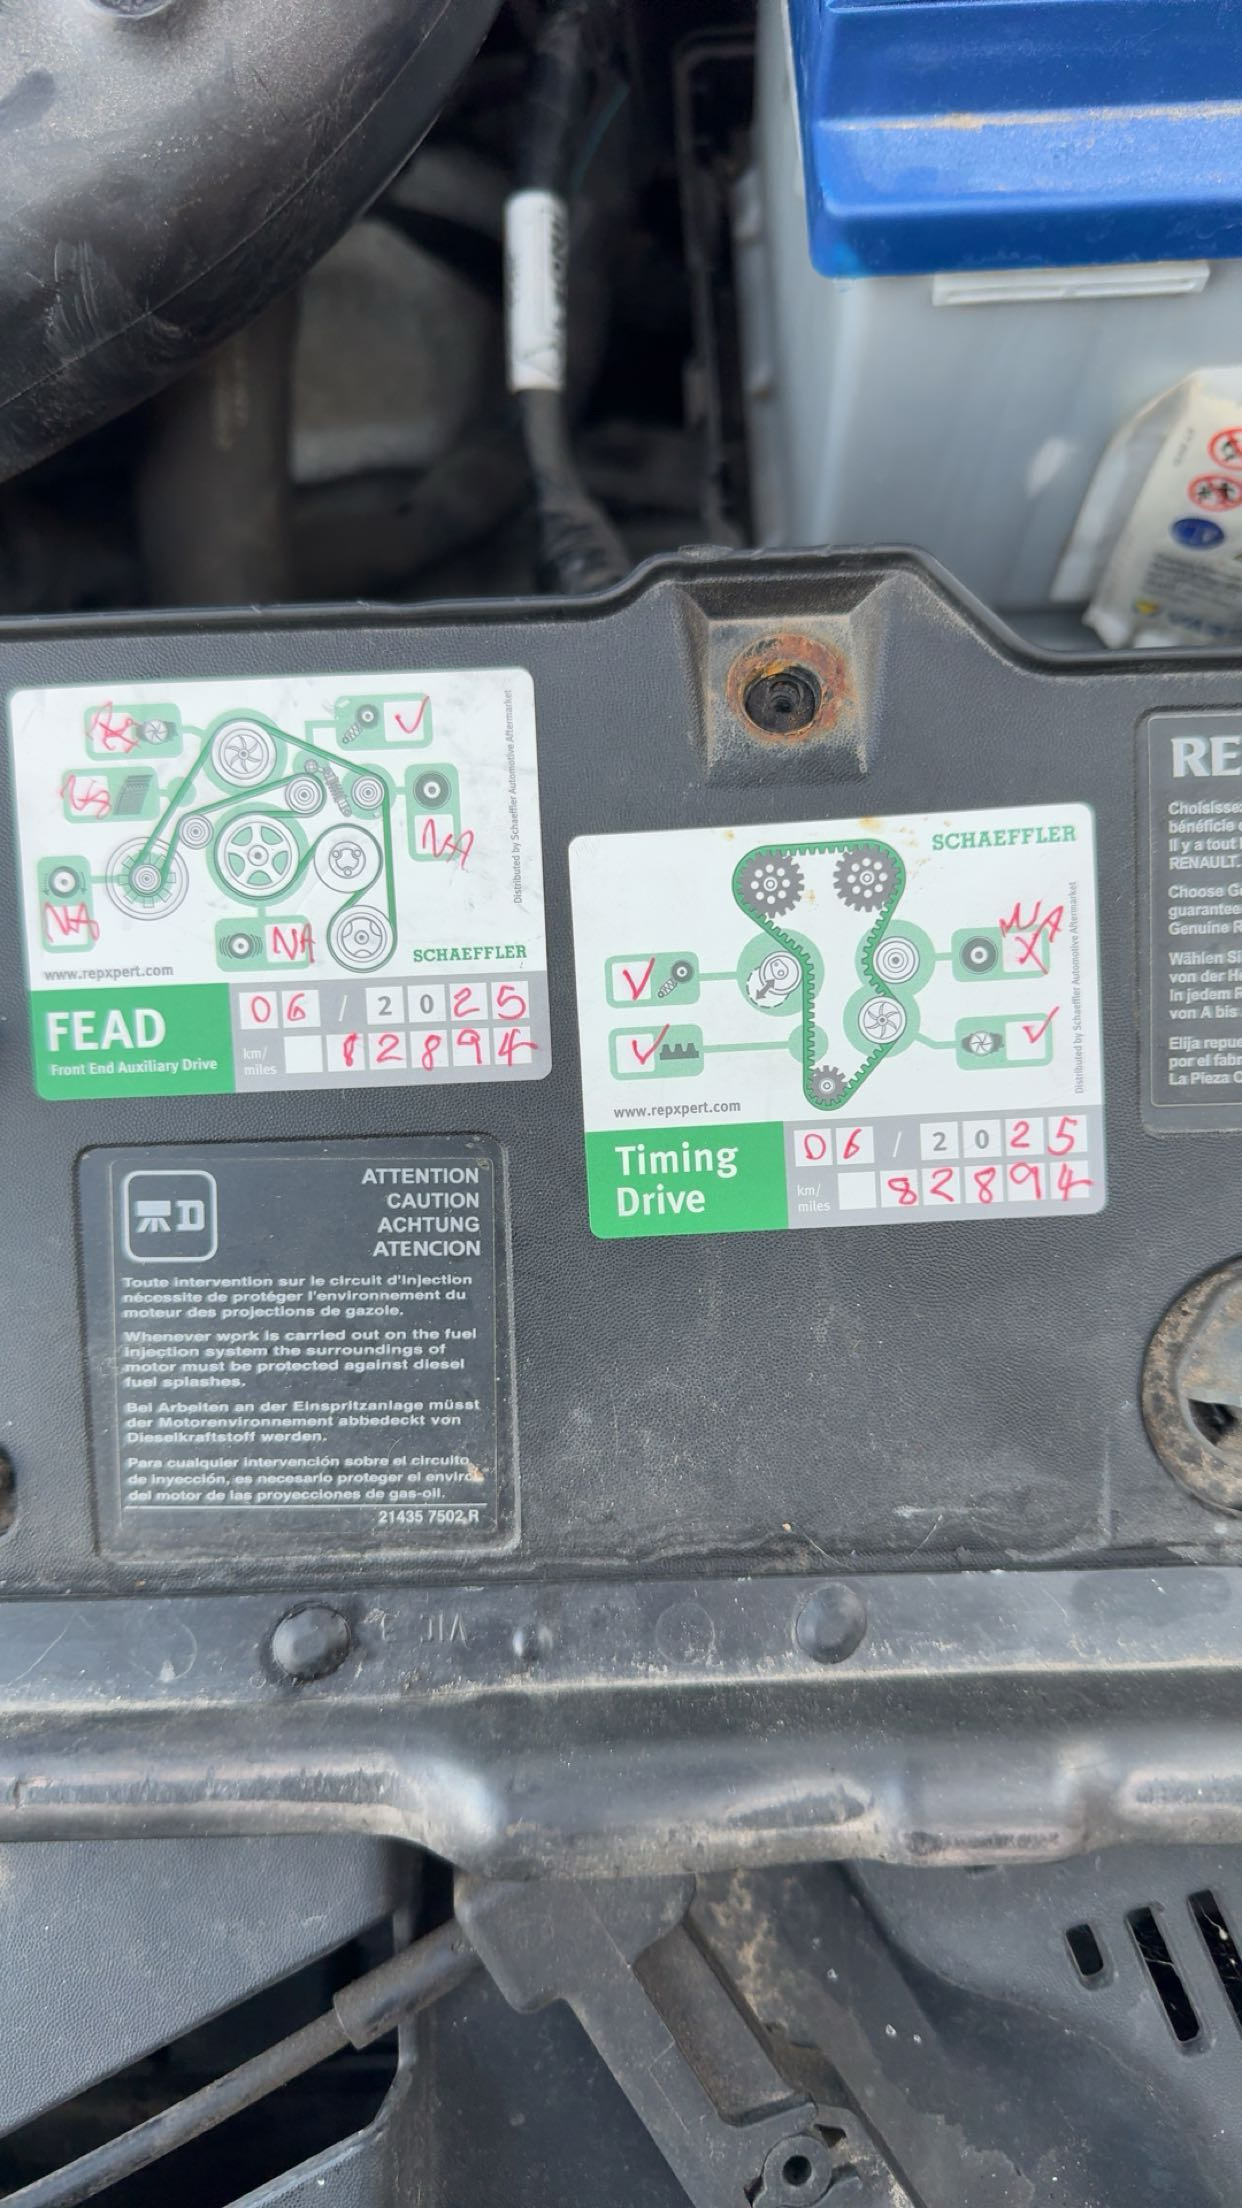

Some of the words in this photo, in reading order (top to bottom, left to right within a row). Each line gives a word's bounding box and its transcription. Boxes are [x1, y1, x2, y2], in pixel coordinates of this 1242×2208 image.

[503, 689, 514, 743] Aftermarket
[505, 743, 517, 795] Automotive
[1168, 800, 1242, 815] Choisisse
[508, 797, 519, 841] Schaeffler
[1168, 818, 1235, 834] bénéficie
[932, 825, 1077, 851] SCHAEFFLER
[1181, 841, 1191, 854] y
[1194, 840, 1203, 851] a
[1206, 837, 1237, 851] tout
[511, 841, 521, 854] by
[513, 853, 523, 904] Distributed
[1168, 884, 1225, 899] Choose
[1228, 882, 1242, 897] G
[1068, 881, 1079, 933] Aftermarket
[1168, 920, 1230, 936] Genuine
[272, 922, 315, 964] NA
[413, 945, 527, 962] SCHAEFFLER
[1071, 935, 1081, 985] Automotive
[1168, 951, 1224, 966] Wählen
[44, 964, 174, 982] www.repxpert.com
[1168, 972, 1196, 984] von
[1200, 969, 1227, 983] der
[1168, 988, 1183, 1002] In
[1186, 986, 1231, 1004] jedem
[1072, 987, 1082, 1031] Schaeffler
[1168, 1008, 1196, 1020] von
[1200, 1005, 1213, 1019] A
[1215, 1004, 1238, 1018] bis
[46, 1008, 166, 1052] FEAD
[1073, 1033, 1084, 1046] by
[1168, 1036, 1201, 1052] Elija
[51, 1063, 86, 1076] Front
[89, 1062, 115, 1075] End
[118, 1059, 180, 1075] Auxiliary
[182, 1057, 218, 1071] Drive
[244, 1063, 278, 1075] miles
[1074, 1047, 1085, 1094] Distributed
[1168, 1057, 1196, 1071] por
[1197, 1054, 1210, 1067] el
[1168, 1073, 1187, 1086] La
[1190, 1071, 1231, 1085] Pieza
[614, 1101, 741, 1118] www.repxpert.com
[614, 1141, 739, 1179] Timing
[361, 1167, 479, 1185] ATTENTION
[386, 1192, 479, 1209] CAUTION
[617, 1183, 706, 1217] Drive
[798, 1199, 831, 1213] miles
[377, 1216, 480, 1233] ACHTUNG
[372, 1240, 481, 1257] ATENCION
[122, 1276, 170, 1288] Toute
[174, 1275, 273, 1288] intervention
[278, 1278, 306, 1287] sur
[310, 1275, 325, 1286] le
[329, 1274, 382, 1286] circuit
[387, 1274, 473, 1287] d'injection
[123, 1291, 203, 1303] nécessite
[207, 1291, 228, 1302] de
[233, 1290, 303, 1305] protéger
[307, 1289, 440, 1302] l'environnement
[445, 1289, 466, 1300] du
[123, 1308, 182, 1318] moteur
[187, 1307, 217, 1318] des
[221, 1305, 316, 1320] projections
[320, 1305, 341, 1317] de
[345, 1304, 404, 1319] gazole.
[123, 1331, 212, 1342] Whenever
[216, 1330, 259, 1342] work
[264, 1330, 280, 1341] is
[284, 1328, 346, 1341] carried
[351, 1329, 380, 1340] out
[384, 1330, 407, 1340] on
[412, 1328, 440, 1340] the
[444, 1327, 477, 1339] fuel
[124, 1346, 200, 1360] injection
[205, 1348, 268, 1359] system
[273, 1345, 301, 1356] the
[306, 1343, 423, 1358] surroundings
[428, 1343, 447, 1354] of
[124, 1362, 177, 1372] motor
[182, 1361, 225, 1372] must
[229, 1360, 252, 1372] be
[257, 1358, 339, 1374] protected
[344, 1358, 409, 1373] against
[412, 1357, 465, 1370] diesel
[125, 1376, 157, 1388] fuel
[162, 1376, 246, 1389] splashes.
[125, 1402, 152, 1413] Bei
[158, 1401, 229, 1413] Arbeiten
[234, 1402, 254, 1412] an
[260, 1401, 288, 1412] der
[292, 1400, 424, 1413] Einspritzanlage
[429, 1398, 480, 1410] müsst
[127, 1416, 153, 1428] der
[159, 1415, 333, 1428] Motorenvironnement
[338, 1414, 425, 1427] abbedeckt
[431, 1416, 461, 1426] von
[127, 1431, 256, 1443] Dieselkraftstoff
[261, 1430, 327, 1442] werden.
[127, 1457, 162, 1467] Para
[166, 1456, 239, 1470] cualquier
[244, 1455, 339, 1467] intervención
[344, 1455, 389, 1466] sobre
[393, 1455, 406, 1465] el
[411, 1454, 470, 1466] circuito
[128, 1473, 147, 1484] de
[152, 1473, 230, 1486] inyección,
[234, 1475, 253, 1484] es
[258, 1472, 333, 1484] necesario
[337, 1472, 403, 1485] proteger
[407, 1471, 421, 1482] el
[128, 1490, 152, 1501] del
[156, 1491, 202, 1500] motor
[206, 1489, 226, 1500] de
[230, 1489, 253, 1500] las
[257, 1488, 361, 1502] proyecciones
[365, 1488, 385, 1499] de
[389, 1487, 445, 1501] gas-oil.
[378, 1510, 424, 1524] 21435
